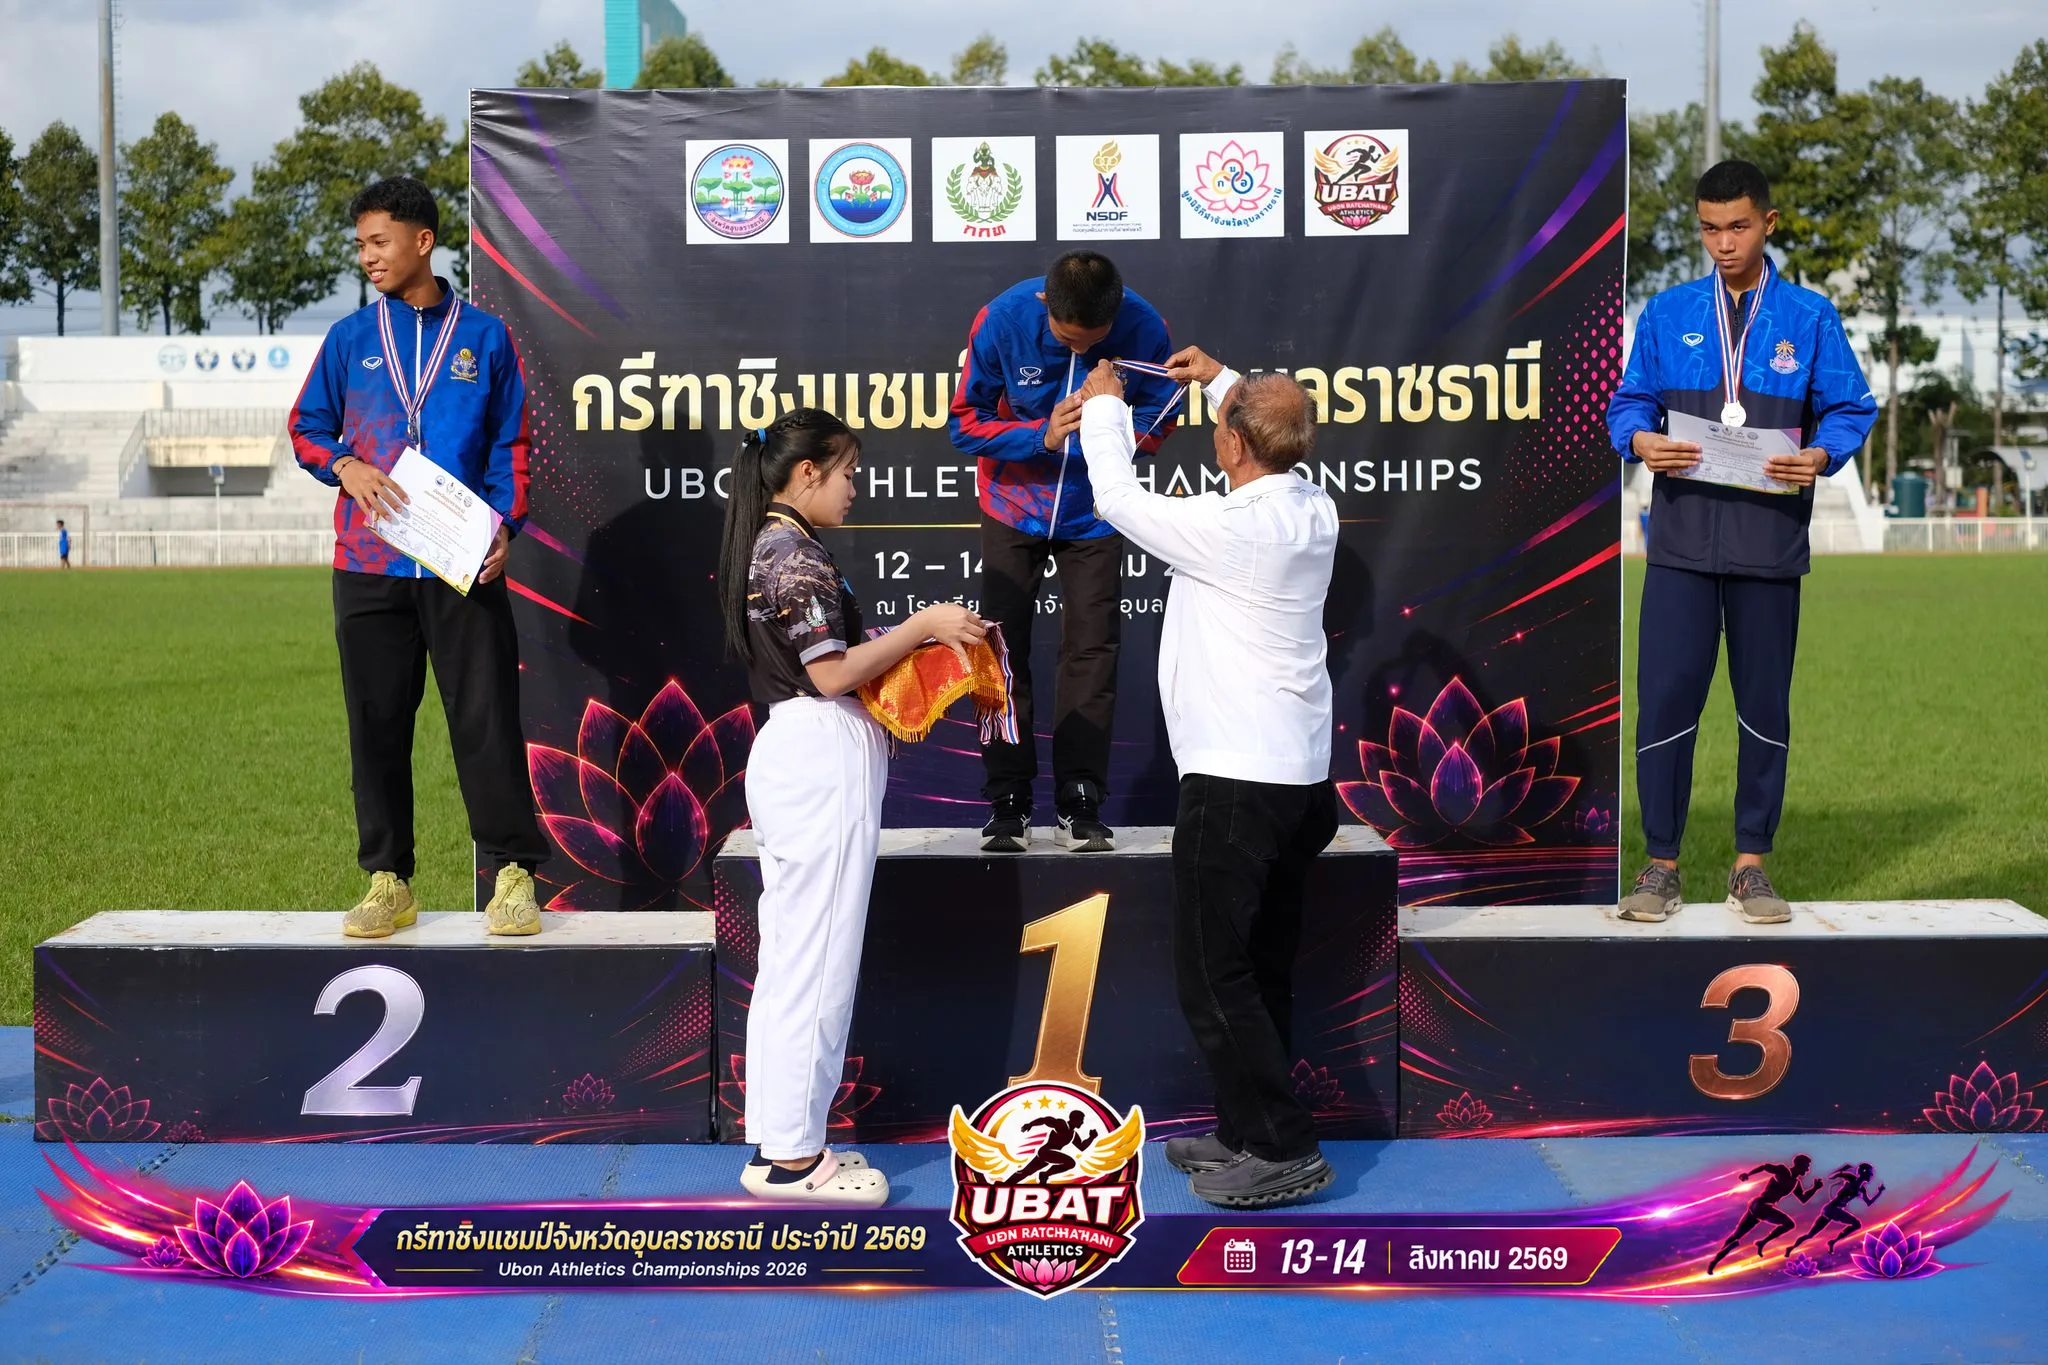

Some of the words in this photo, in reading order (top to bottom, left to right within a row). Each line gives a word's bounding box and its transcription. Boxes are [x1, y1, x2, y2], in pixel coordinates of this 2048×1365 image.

[1321, 184, 1393, 203] UBAT
[1086, 211, 1128, 221] NSDF
[875, 550, 910, 580] 12
[876, 599, 896, 616] ณ
[1006, 893, 1109, 1096] 1
[300, 964, 426, 1117] 2
[1688, 963, 1800, 1101] 3
